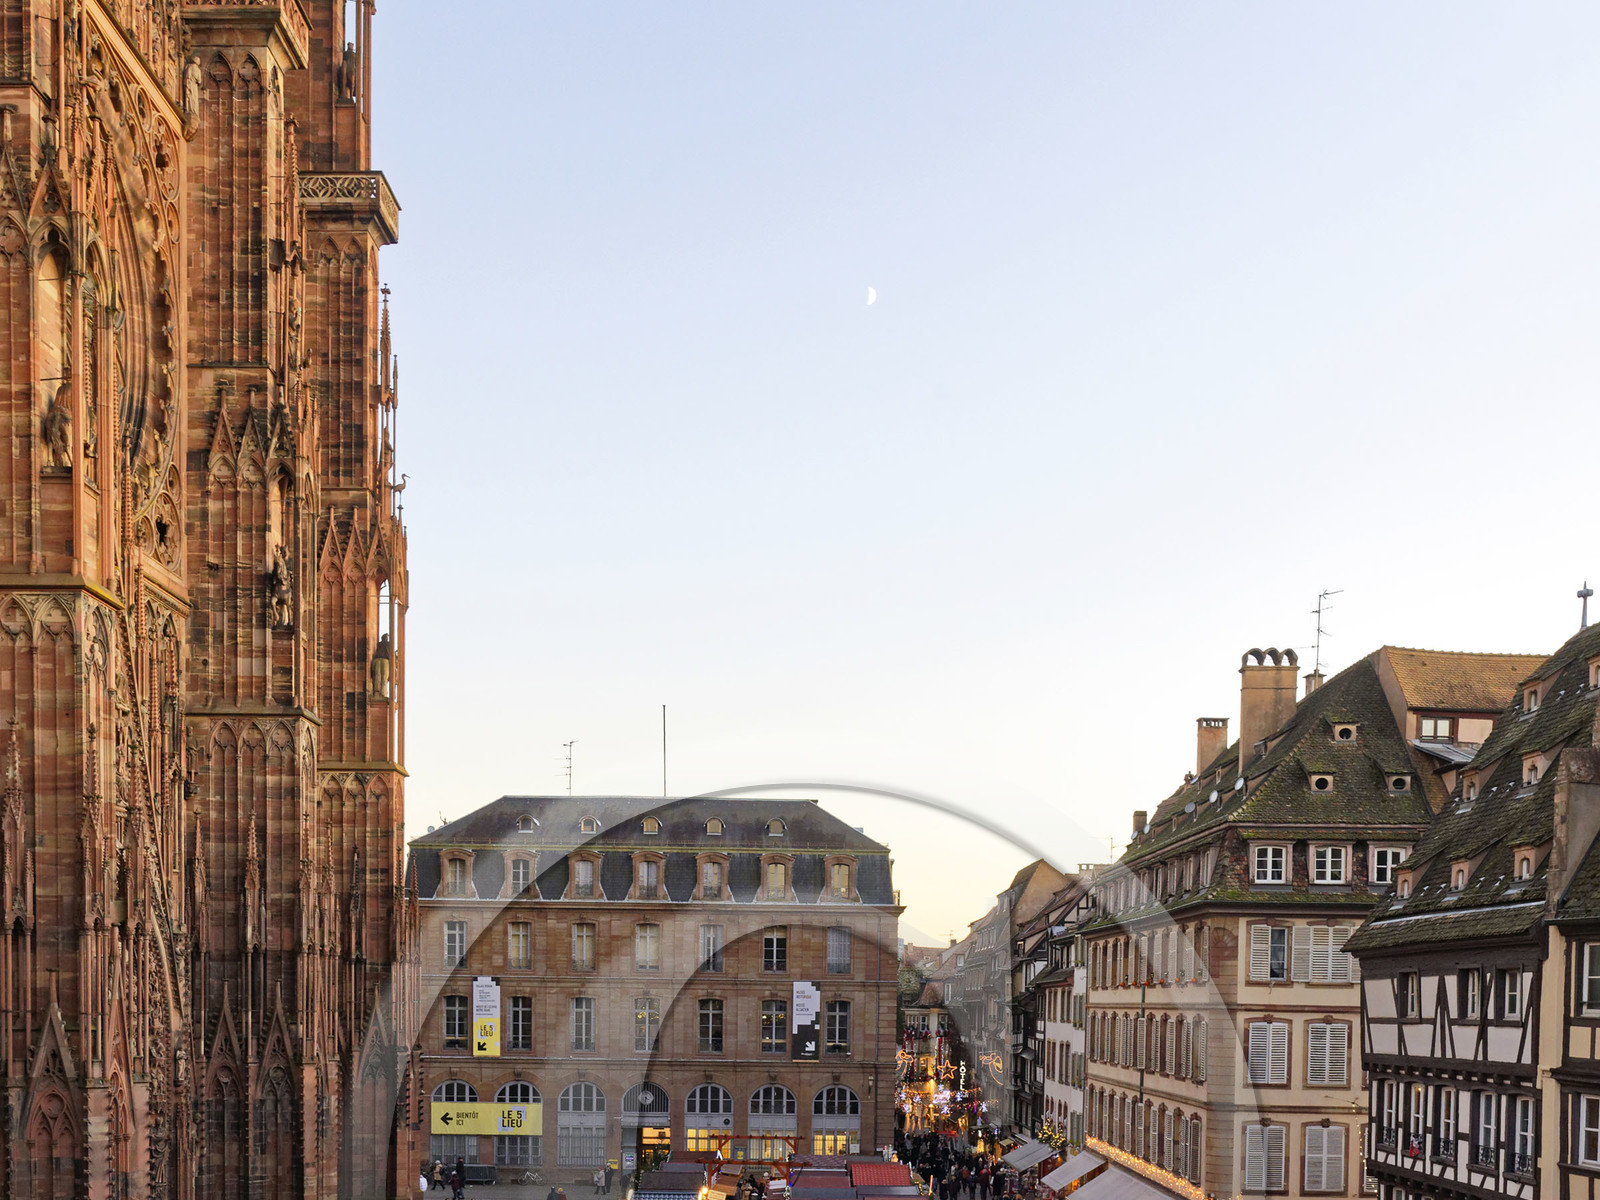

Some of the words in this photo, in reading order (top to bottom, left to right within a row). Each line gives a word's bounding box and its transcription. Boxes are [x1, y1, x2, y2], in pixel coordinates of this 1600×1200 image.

[456, 1111, 479, 1119] BIENTÔT
[502, 1110, 513, 1119] LE
[502, 1119, 523, 1128] LIEU
